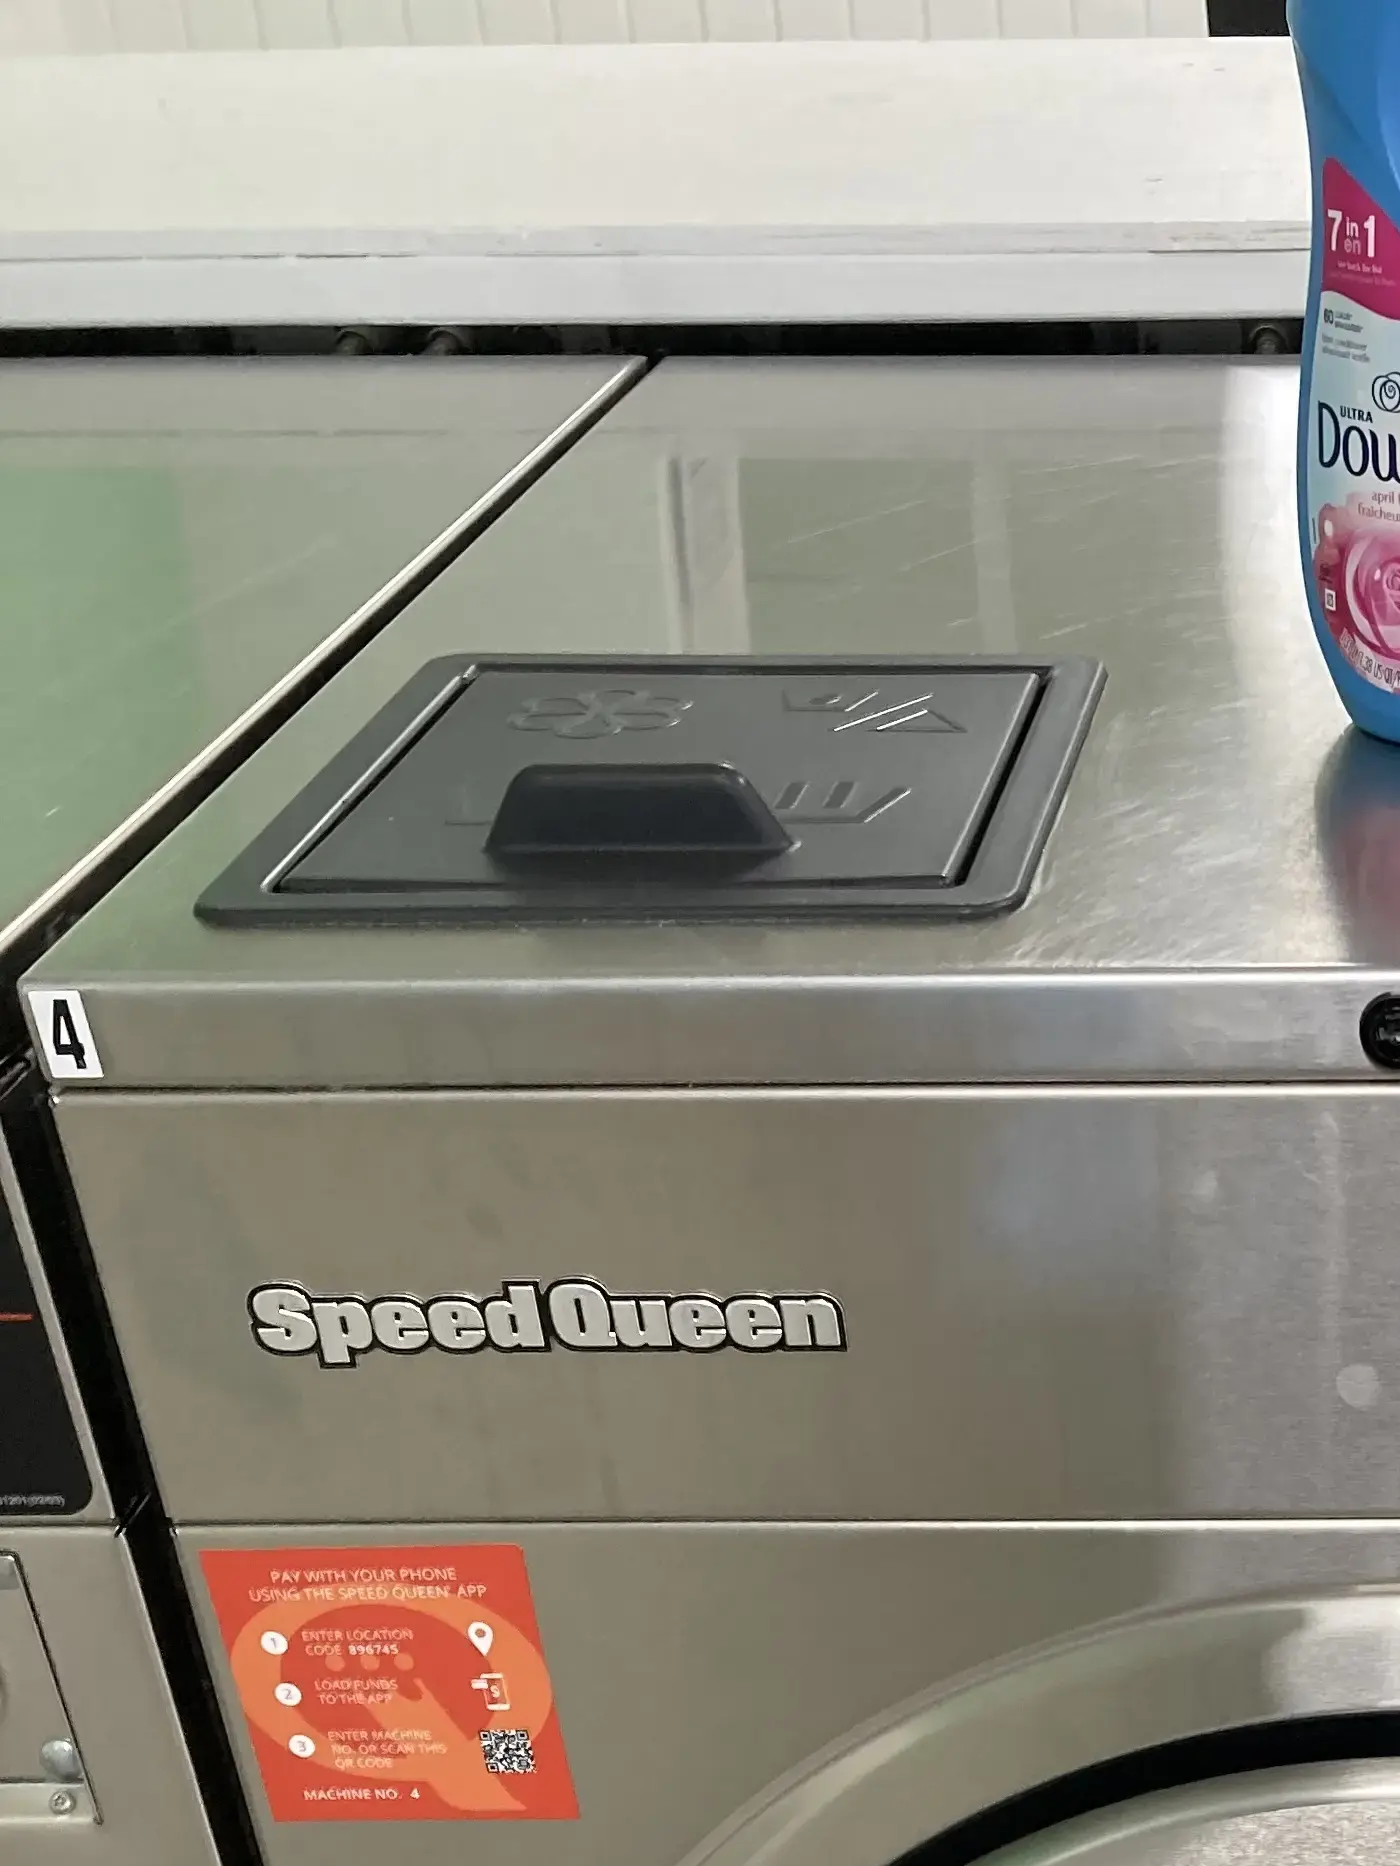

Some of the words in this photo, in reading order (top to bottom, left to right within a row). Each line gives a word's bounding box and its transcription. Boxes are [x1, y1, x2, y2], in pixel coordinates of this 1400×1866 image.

[1327, 208, 1343, 252] 7
[1346, 216, 1360, 238] in
[1363, 215, 1376, 258] 1
[1344, 238, 1362, 255] en
[1340, 405, 1373, 423] ULTRA
[1371, 491, 1395, 506] april
[52, 999, 87, 1070] 4
[248, 1278, 549, 1368] Speed
[549, 1275, 847, 1354] Queen
[270, 1570, 301, 1584] PAY
[304, 1568, 347, 1583] WITH
[350, 1568, 396, 1583] YOUR
[398, 1567, 457, 1582] PHONE
[248, 1587, 301, 1602] USING
[303, 1586, 335, 1601] THE
[338, 1586, 388, 1600] SPEED
[456, 1584, 488, 1598] APP
[301, 1630, 344, 1642] ENTER
[346, 1627, 414, 1642] LOCATION
[305, 1644, 343, 1656] CODE
[314, 1680, 350, 1691] LOAD
[353, 1679, 399, 1691] FUNDS
[327, 1730, 368, 1742] ENTER
[371, 1729, 433, 1742] MACHINE
[380, 1743, 416, 1755] SCAN
[418, 1743, 447, 1754] THIS
[303, 1788, 373, 1801] MACHINE
[410, 1788, 420, 1799] 4
